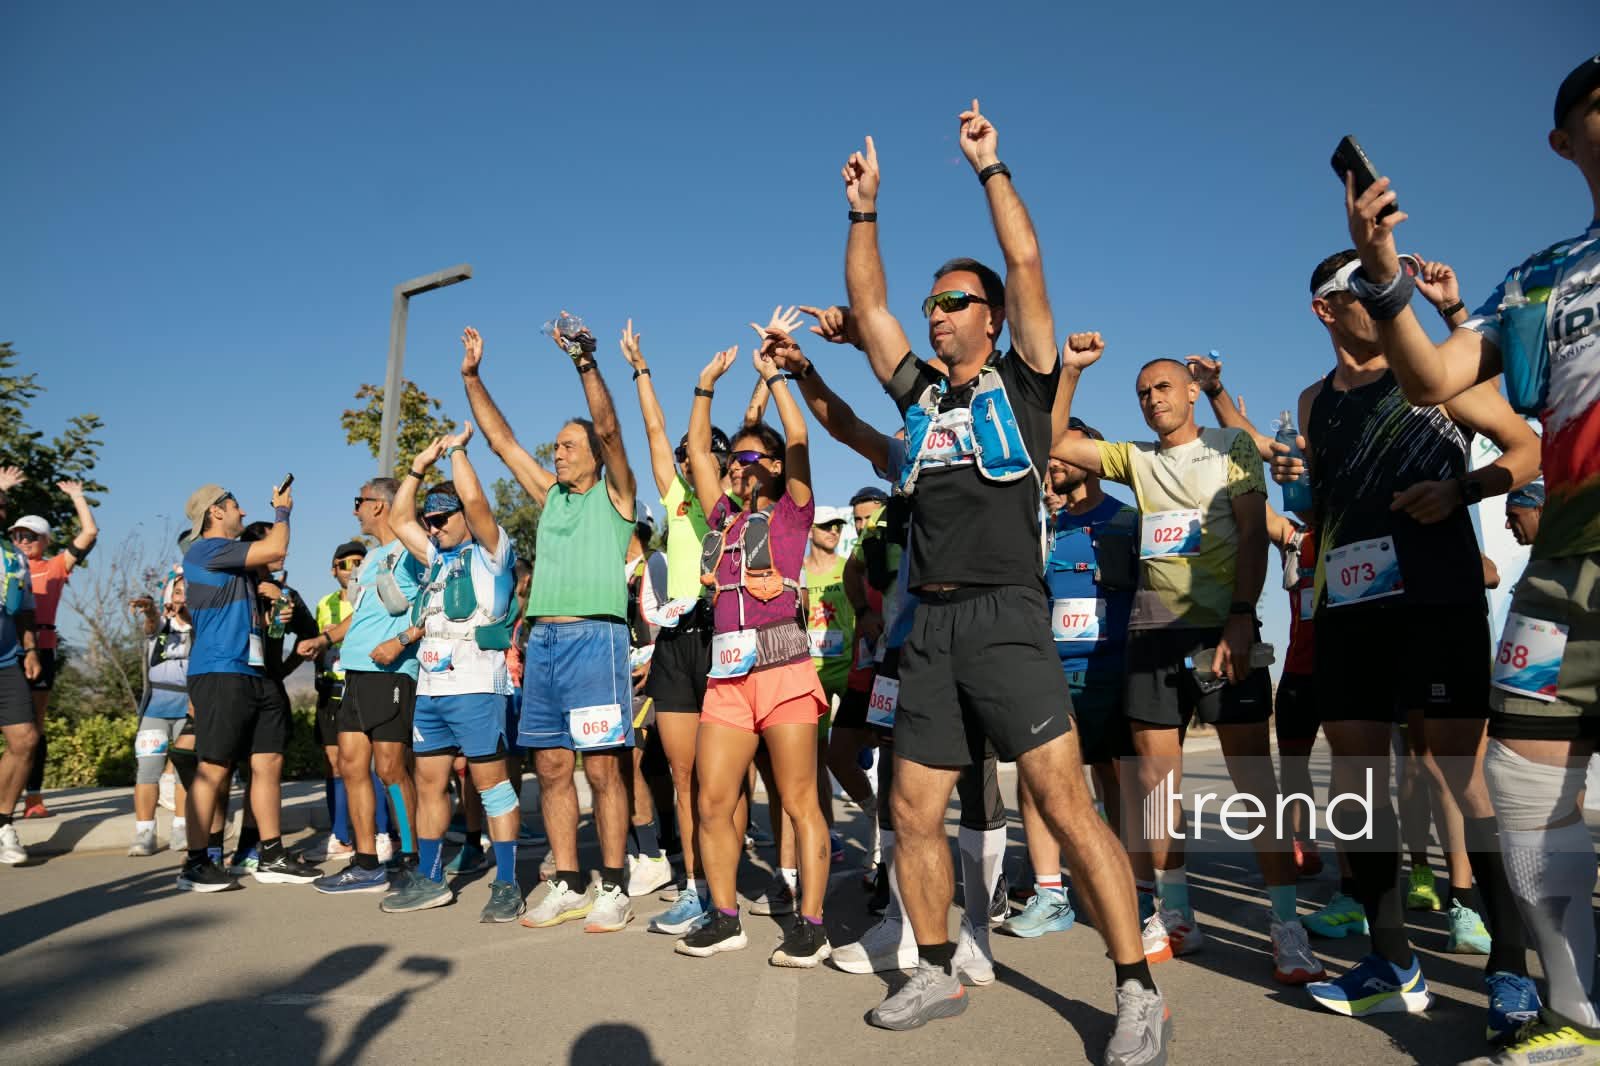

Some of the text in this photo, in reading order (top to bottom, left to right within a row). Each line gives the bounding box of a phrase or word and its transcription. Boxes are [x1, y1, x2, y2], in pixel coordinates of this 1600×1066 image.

[926, 430, 958, 450] 039
[1153, 526, 1184, 544] 022
[1340, 562, 1376, 586] 073
[1062, 613, 1090, 628] 077
[422, 650, 440, 663] 084
[720, 647, 742, 665] 002
[1495, 640, 1529, 669] 58
[869, 692, 894, 713] 085
[582, 719, 609, 736] 068
